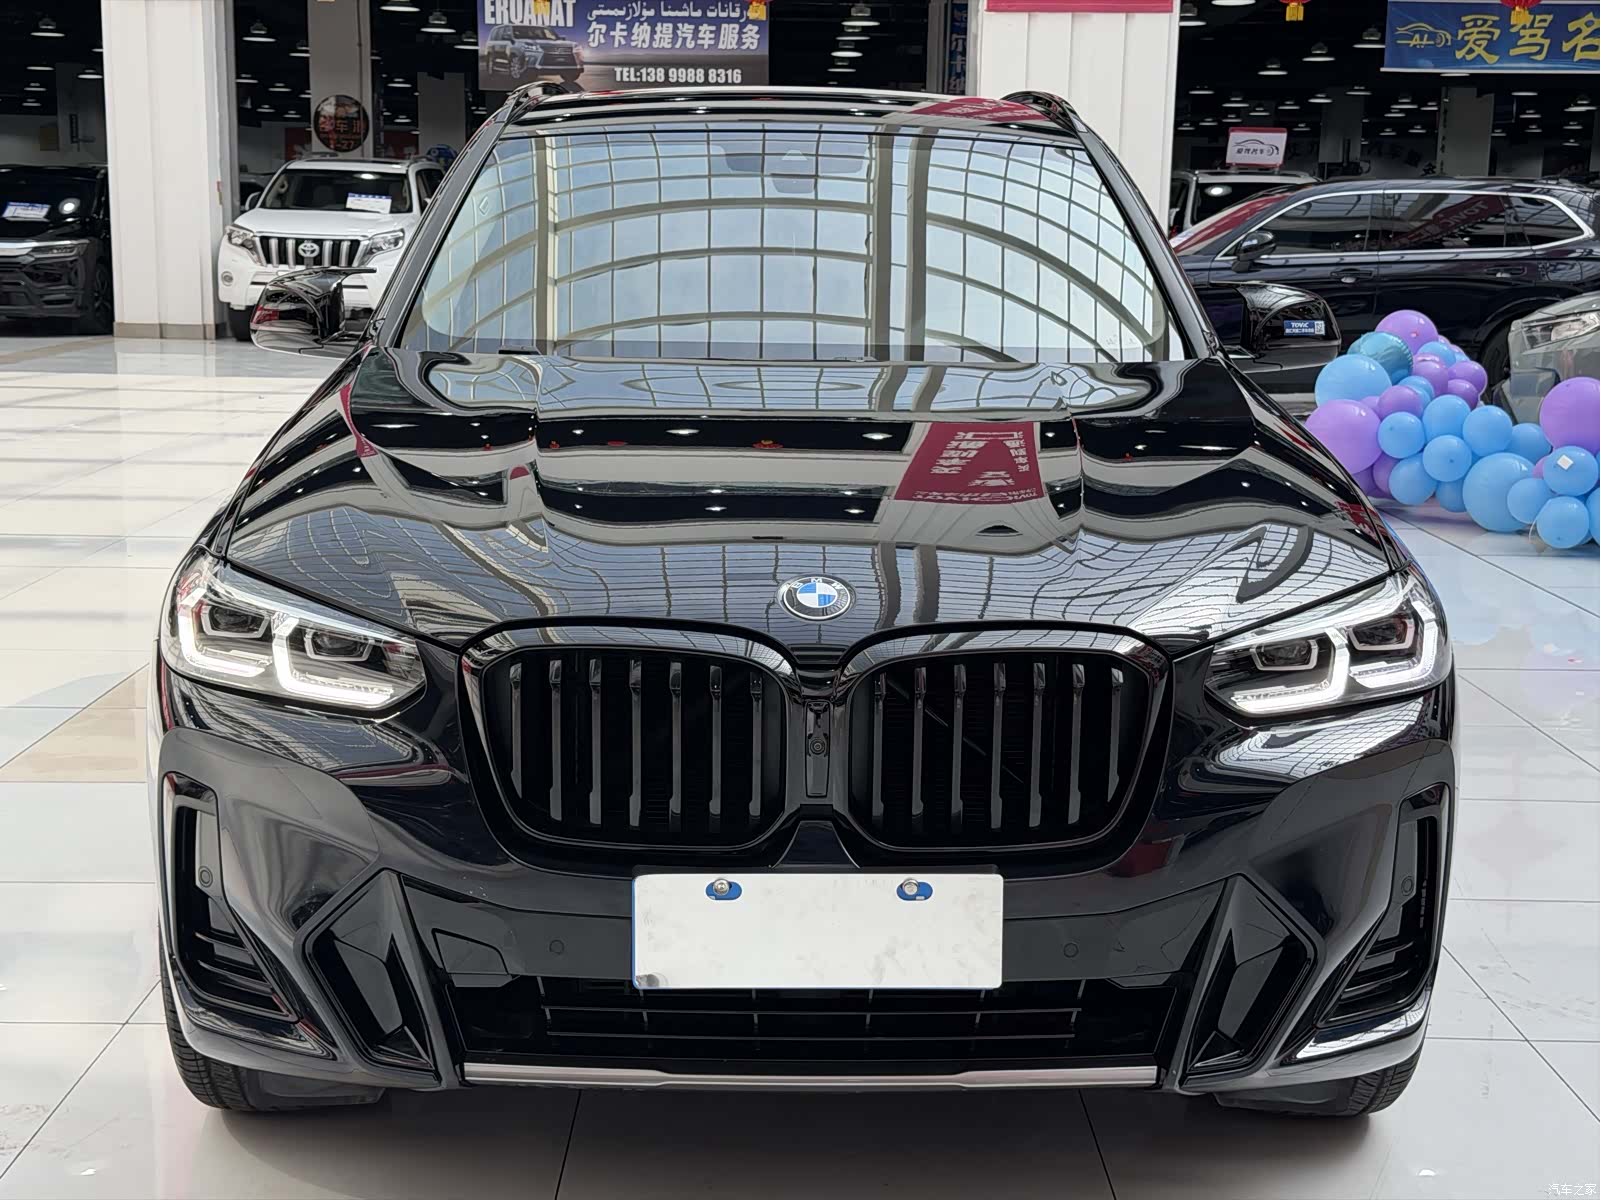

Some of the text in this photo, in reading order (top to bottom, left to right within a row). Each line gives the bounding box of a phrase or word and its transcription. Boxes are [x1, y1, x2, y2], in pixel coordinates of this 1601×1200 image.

[587, 22, 761, 50] 尔卡纳提汽车服务
[615, 67, 742, 84] TEL:138 9988 8316
[791, 578, 844, 590] BMW
